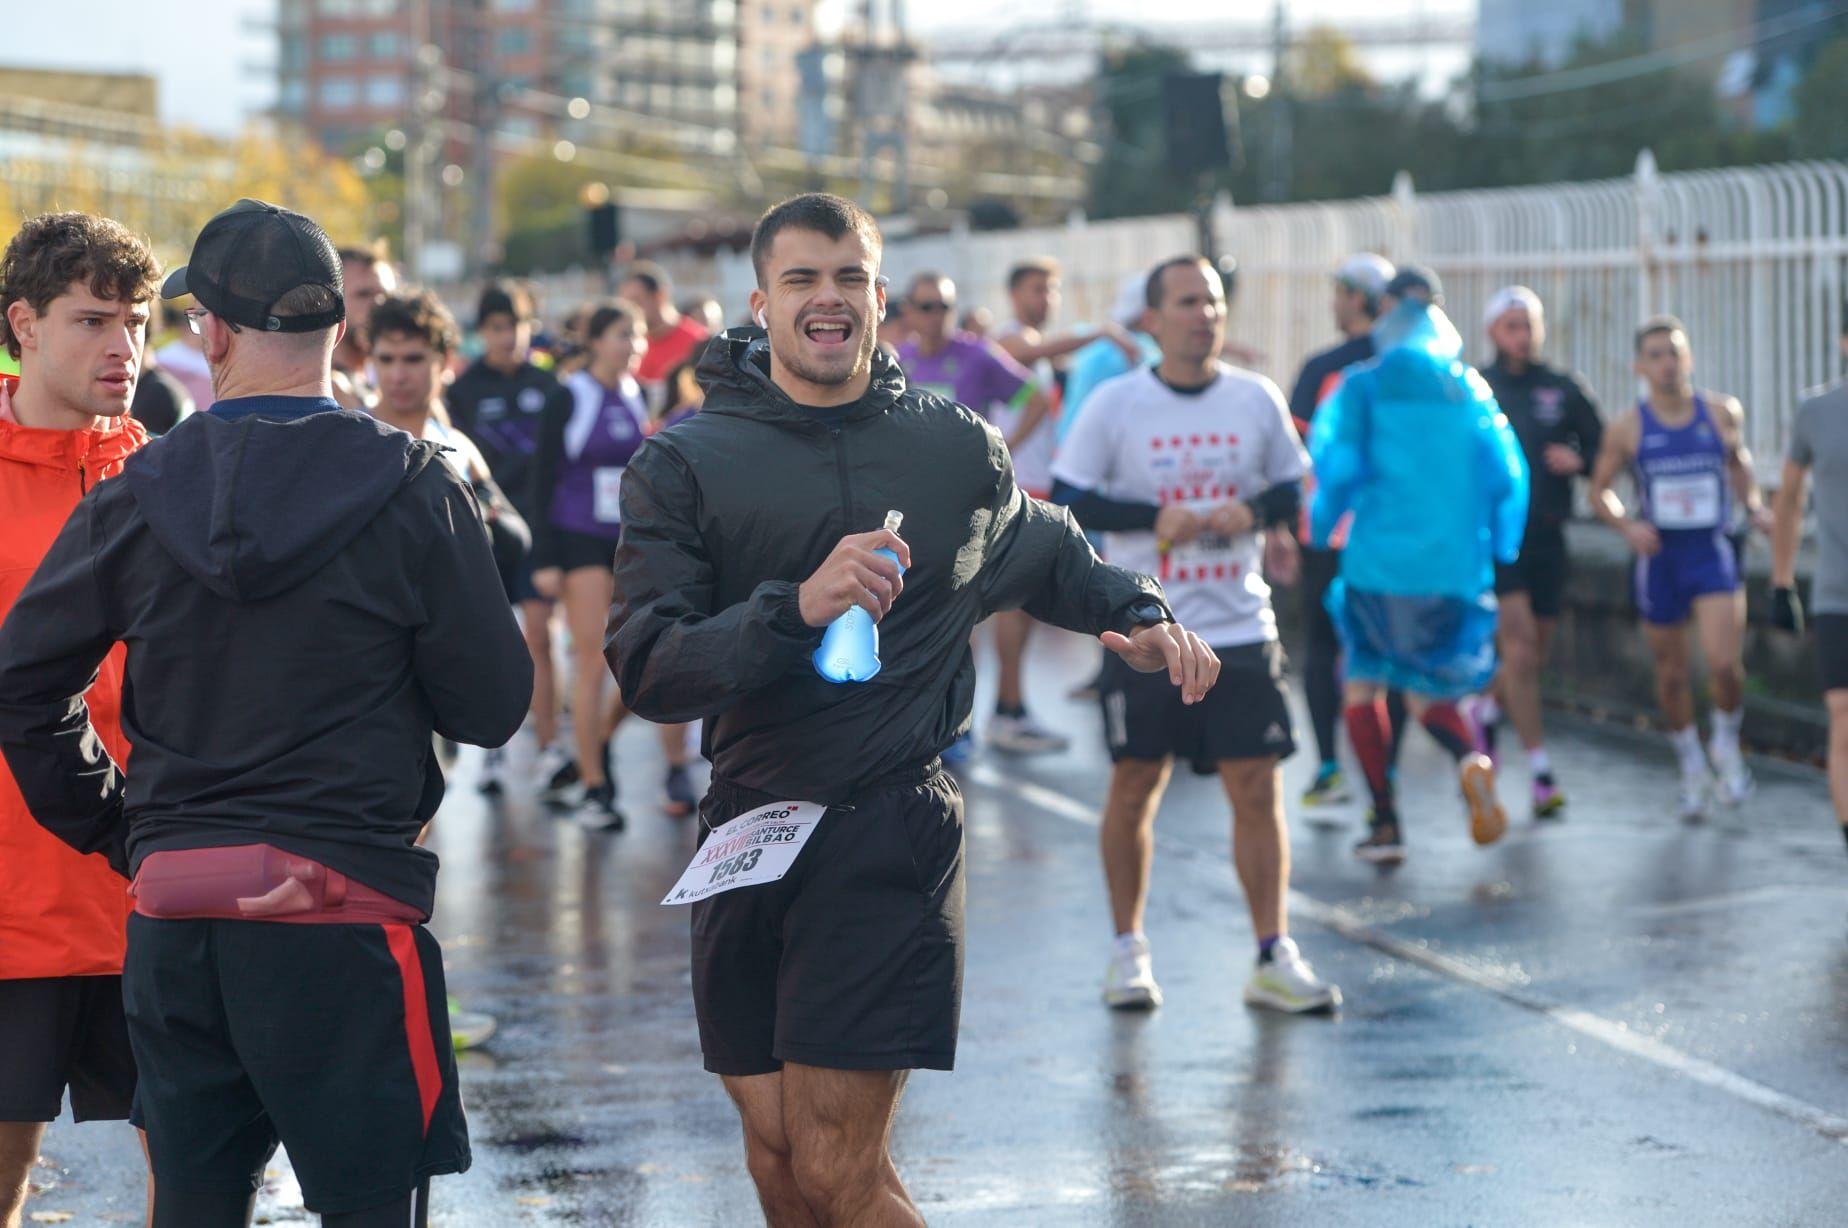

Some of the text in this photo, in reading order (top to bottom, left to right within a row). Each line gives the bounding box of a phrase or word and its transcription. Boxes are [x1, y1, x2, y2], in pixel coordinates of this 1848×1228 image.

[740, 810, 791, 829] CORREO
[751, 825, 801, 837] SANTURCE
[744, 832, 796, 848] BILBAO
[708, 848, 764, 884] 1583
